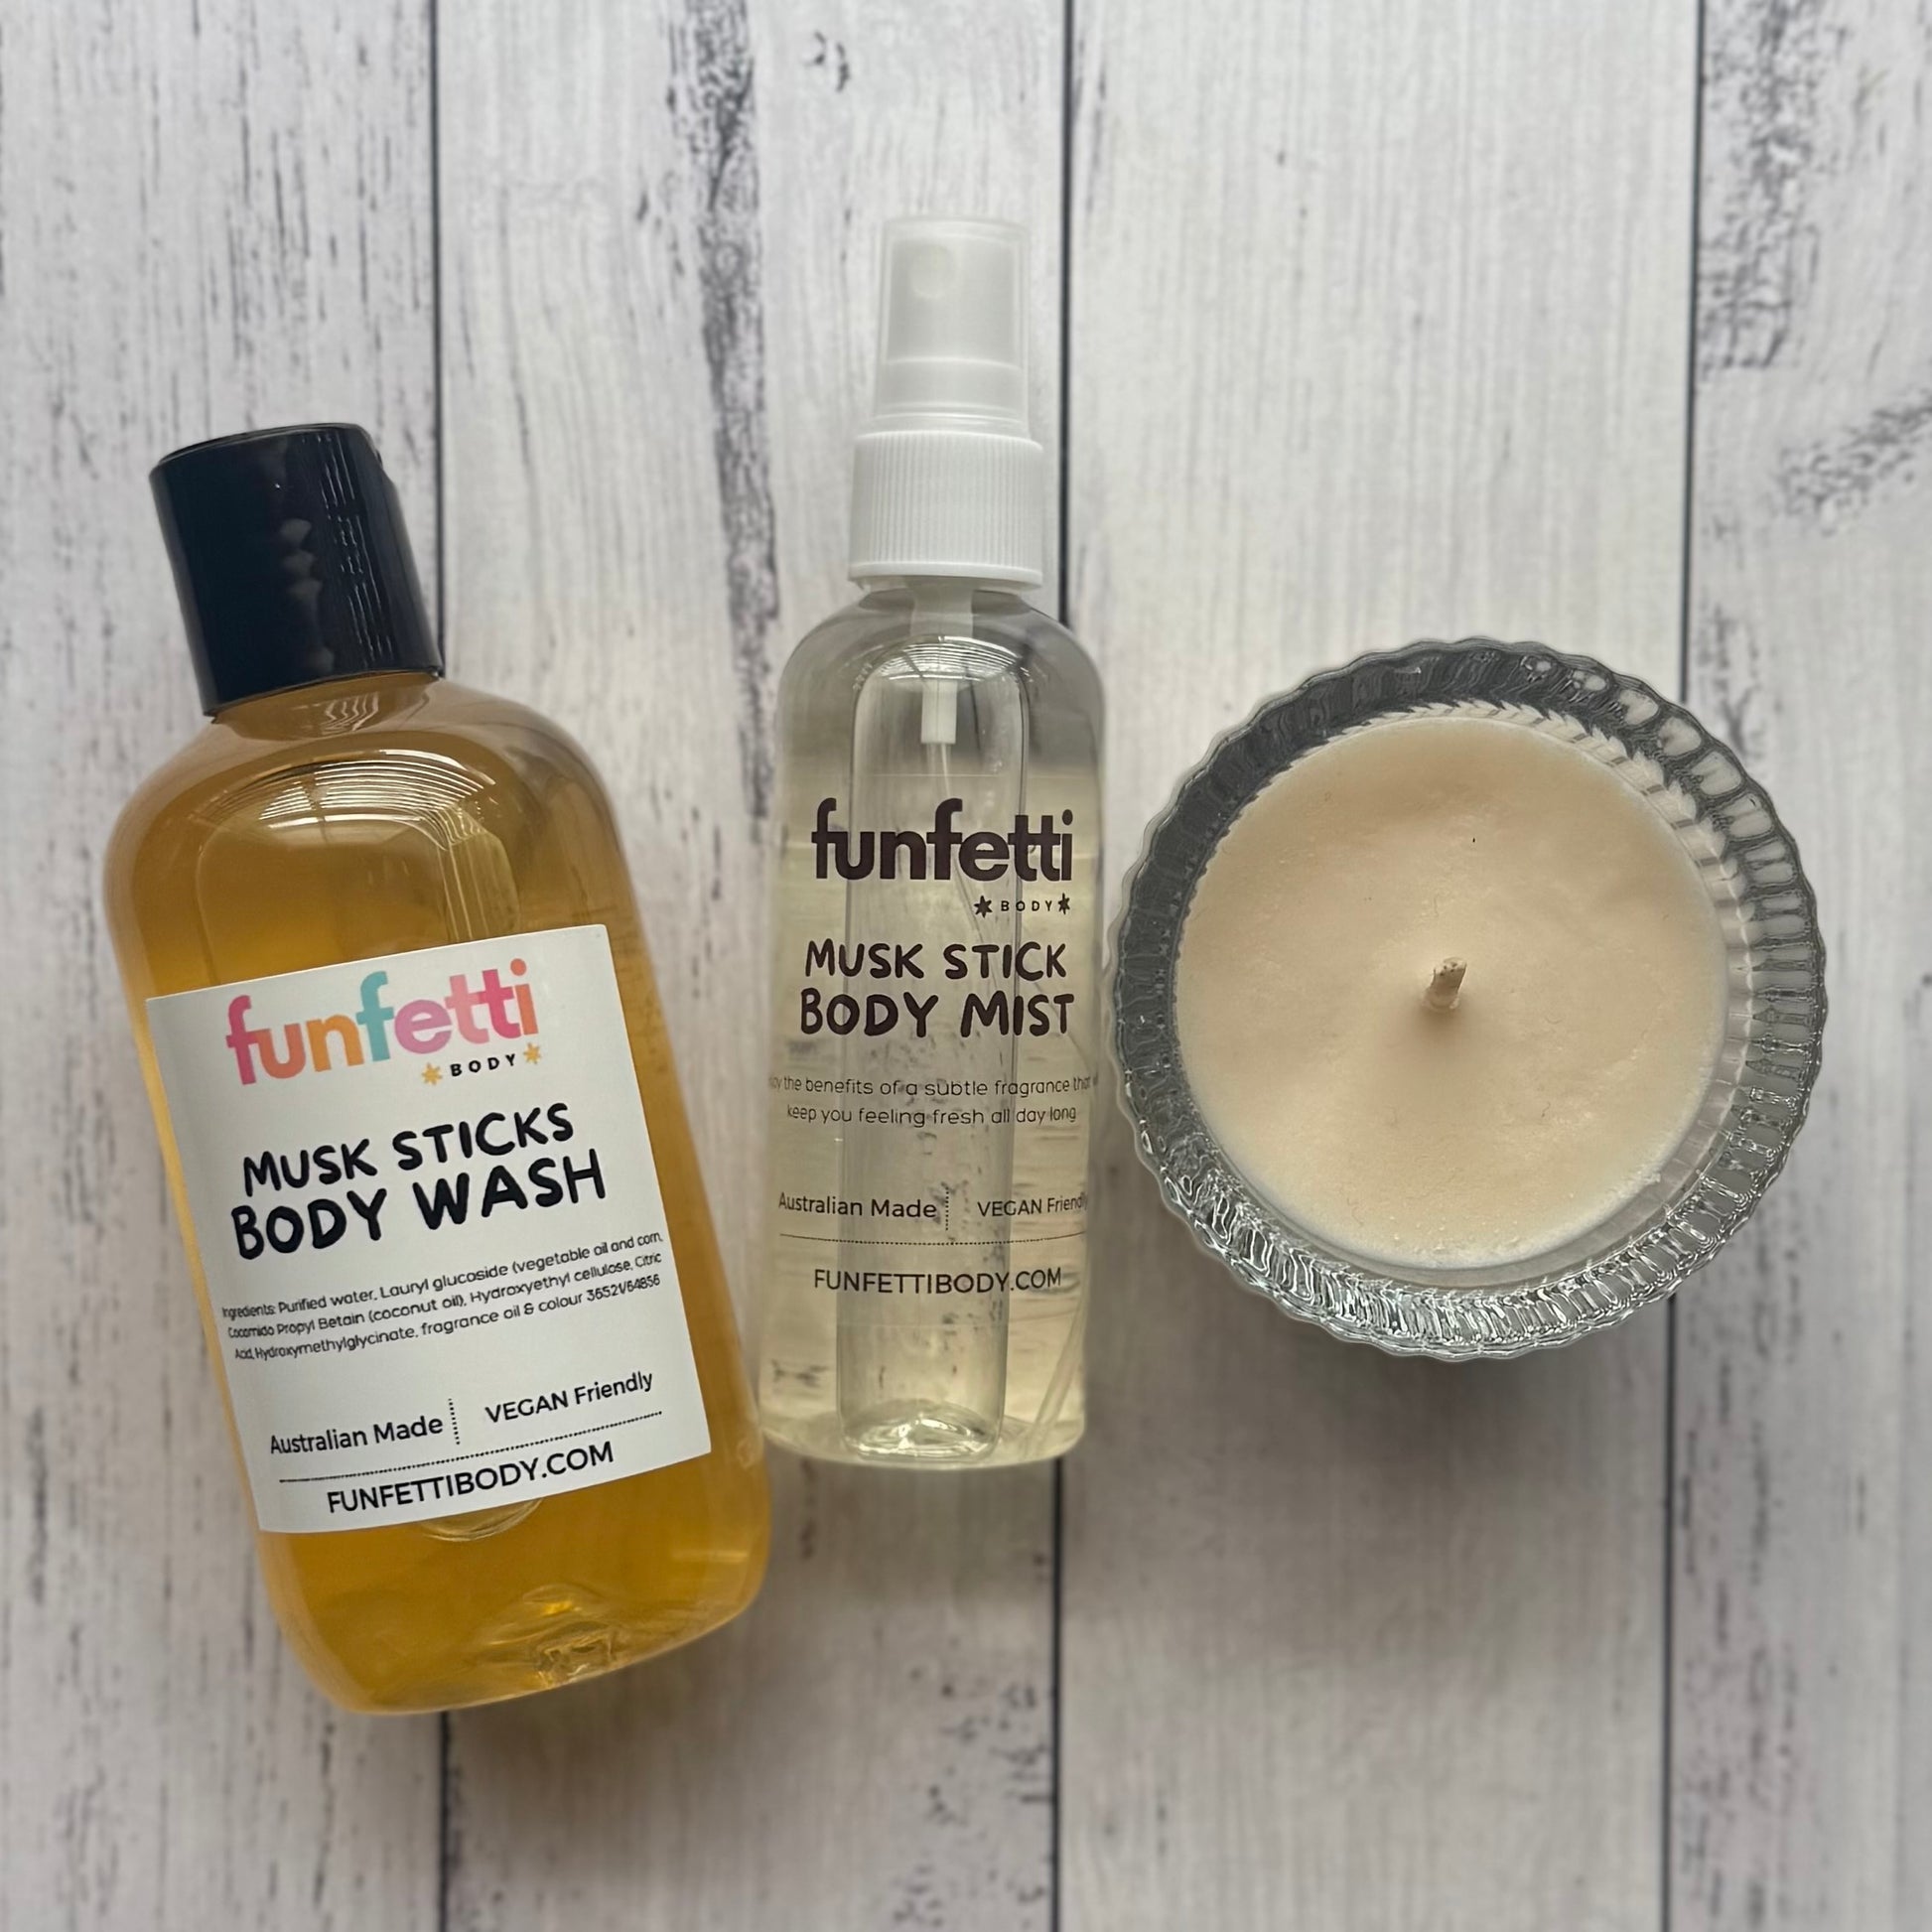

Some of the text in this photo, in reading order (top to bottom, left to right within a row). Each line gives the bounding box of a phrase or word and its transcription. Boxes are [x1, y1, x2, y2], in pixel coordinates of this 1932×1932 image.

[811, 797, 1073, 882] funfetti
[1001, 899, 1053, 912] BODY
[805, 938, 1066, 981] MUSK STICK
[225, 958, 539, 1085] funfetti
[801, 987, 1074, 1037] BODY MIST
[450, 1052, 517, 1077] BODY
[783, 1075, 802, 1091] the
[805, 1076, 874, 1094] benefits
[880, 1079, 900, 1095] of
[905, 1082, 918, 1096] a
[924, 1080, 988, 1096] subtle
[995, 1078, 1070, 1098] fragrance
[787, 1104, 1076, 1129] keep you feeling fresh all day long
[243, 1102, 574, 1196] MUSK STICKS
[231, 1148, 606, 1260] BODY WASH
[778, 1191, 937, 1218] Australian Made
[978, 1197, 1042, 1218] VEGAN
[278, 1295, 328, 1314] Purified
[379, 1278, 429, 1300] Lauryl
[432, 1265, 508, 1293] glucoside
[512, 1247, 591, 1275] (vegetable
[593, 1241, 609, 1256] oil
[611, 1235, 634, 1252] and
[814, 1267, 1062, 1294] FUNFETTIBODY.COM
[276, 1318, 316, 1335] Propyl
[318, 1311, 364, 1329] Betain
[368, 1299, 438, 1323] (coconut
[470, 1272, 571, 1305] Hydroxyethyl
[420, 1311, 499, 1336] fragrance
[503, 1305, 520, 1320] oil
[523, 1302, 535, 1315] &
[538, 1293, 583, 1313] colour
[484, 1371, 653, 1424] VEGAN Friendly
[270, 1416, 444, 1454] Australian Made
[327, 1441, 615, 1514] FUNFETTIBODY.COM
